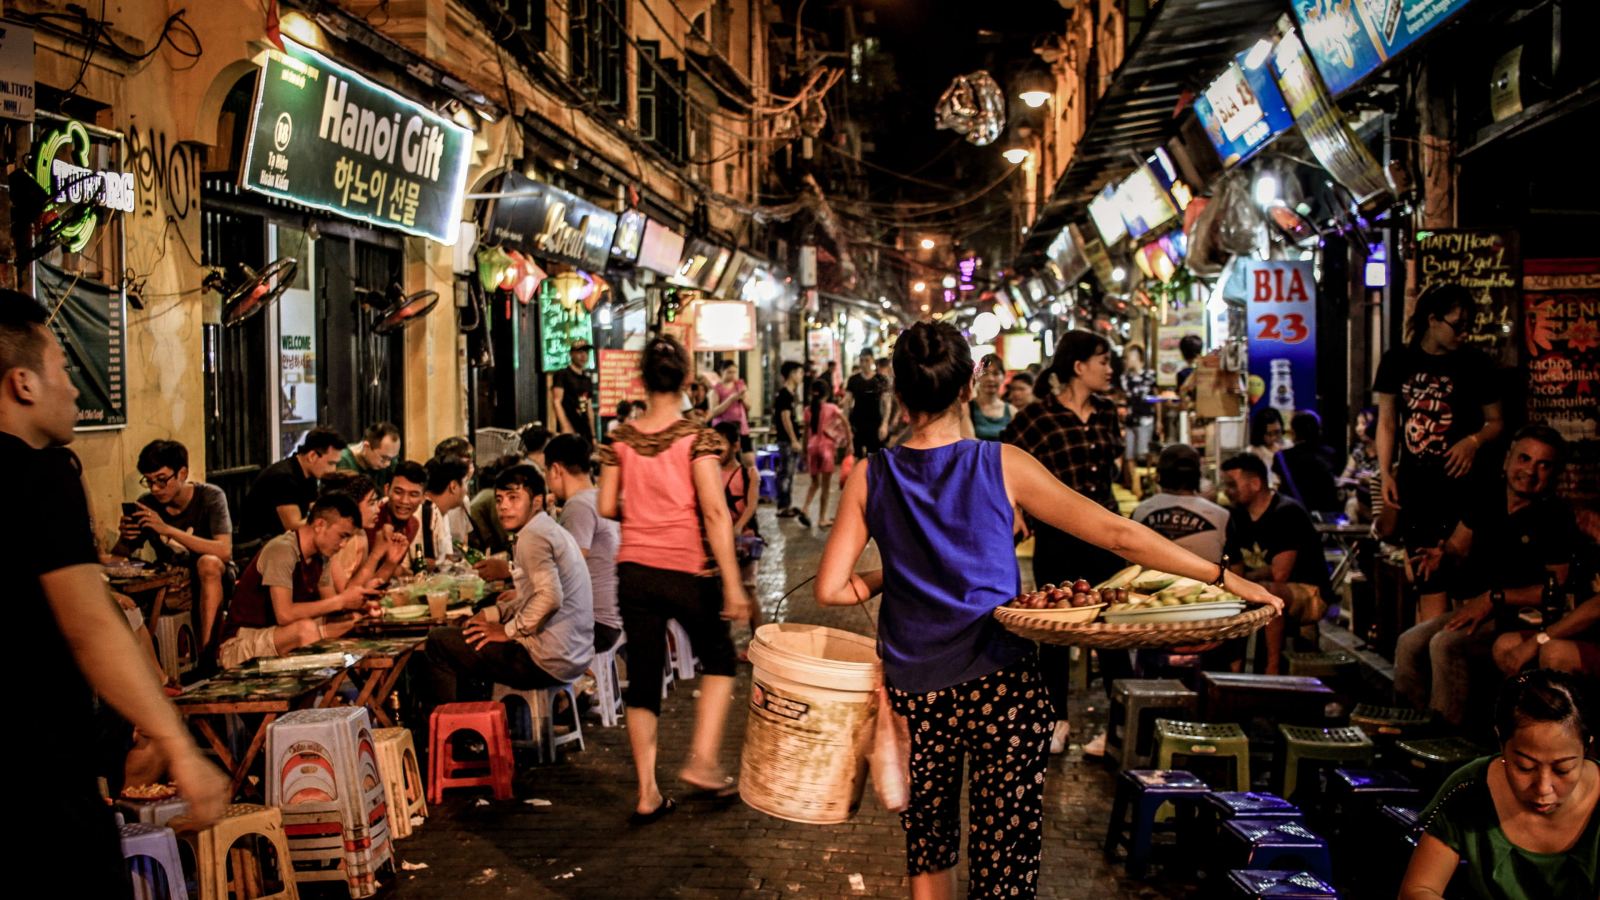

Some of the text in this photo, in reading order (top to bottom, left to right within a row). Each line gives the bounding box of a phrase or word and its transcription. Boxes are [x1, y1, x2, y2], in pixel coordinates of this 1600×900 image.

[319, 74, 445, 183] Hanoi Gift
[333, 155, 421, 227] 하노이 선물
[1423, 247, 1510, 276] Buy 2 get 1
[1253, 268, 1309, 303] BIA
[1546, 302, 1600, 318] MEN
[281, 336, 312, 351] WELCOME
[1256, 313, 1310, 344] 23
